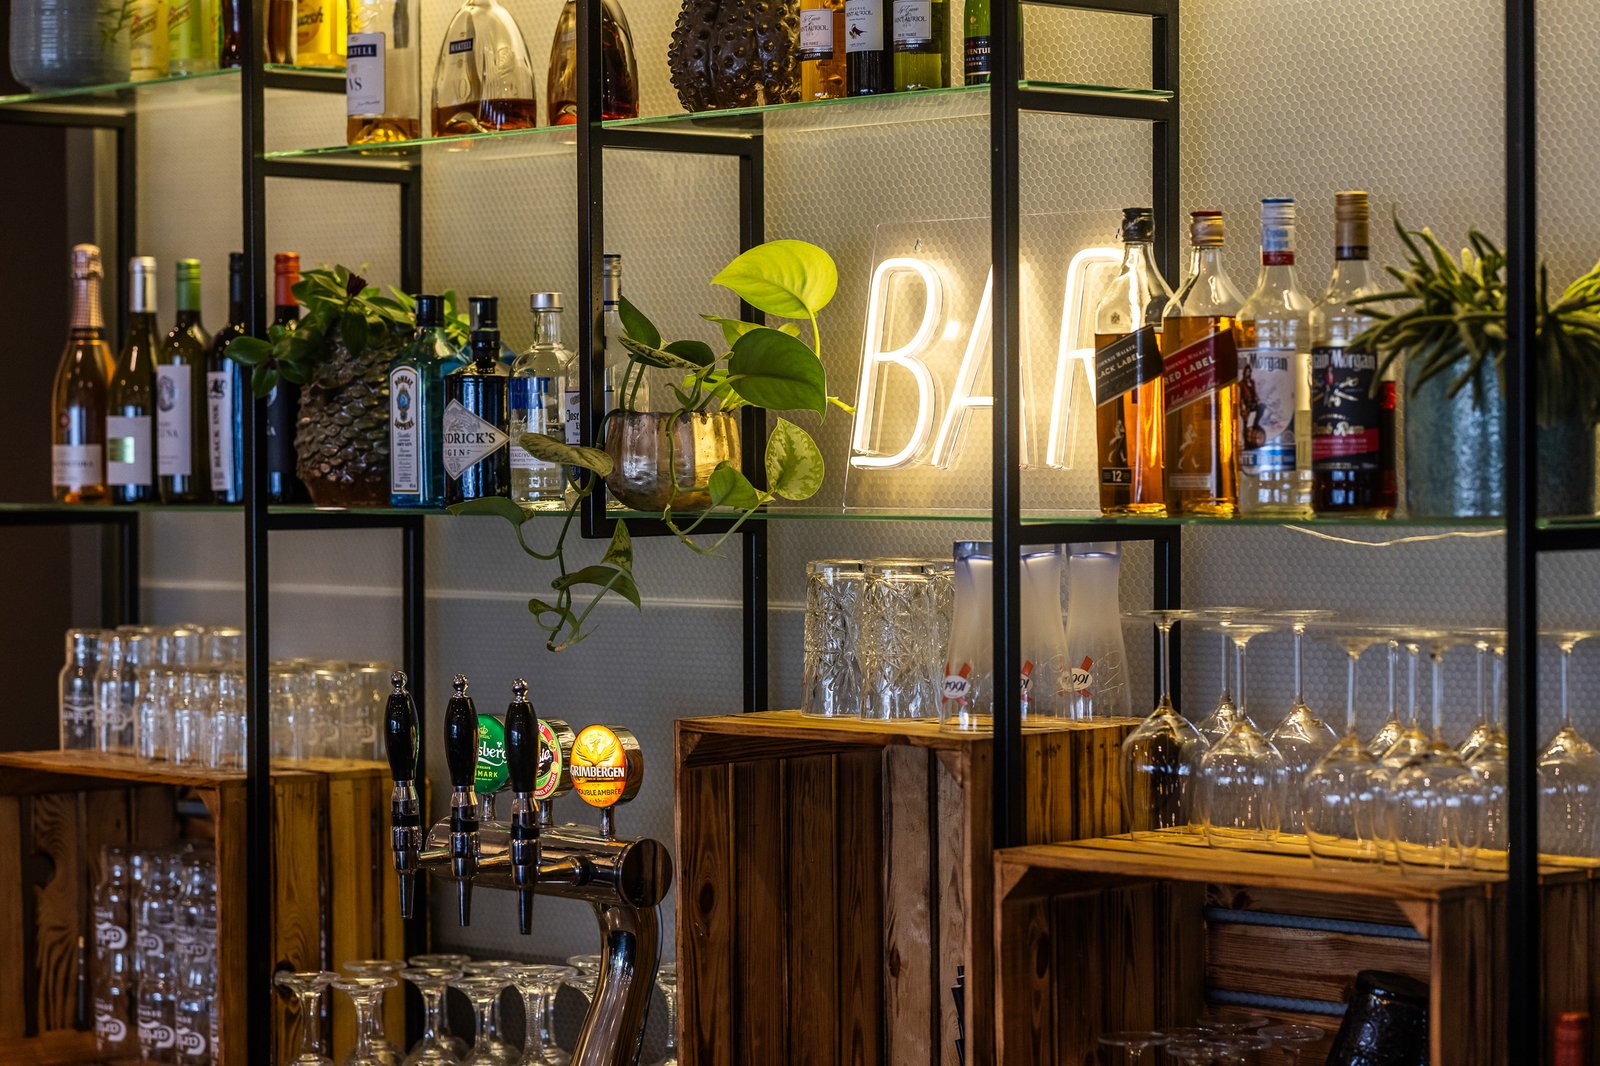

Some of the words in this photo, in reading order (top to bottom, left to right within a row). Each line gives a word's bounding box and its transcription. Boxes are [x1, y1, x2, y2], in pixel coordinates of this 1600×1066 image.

[850, 247, 1123, 472] BAR
[1097, 364, 1116, 380] LACK
[1116, 352, 1144, 369] LABEL
[1248, 352, 1288, 372] Morgan
[1331, 349, 1376, 372] Morgan
[1164, 370, 1181, 385] RED
[1183, 355, 1216, 376] LABEL
[443, 432, 496, 444] NDRICK'S
[1111, 470, 1122, 482] 12
[1020, 678, 1029, 689] 16
[1072, 673, 1089, 684] 166
[944, 680, 967, 693] 1664
[477, 770, 498, 778] MARK
[570, 764, 625, 778] GRIMBERGEN
[578, 788, 597, 796] OUBLE
